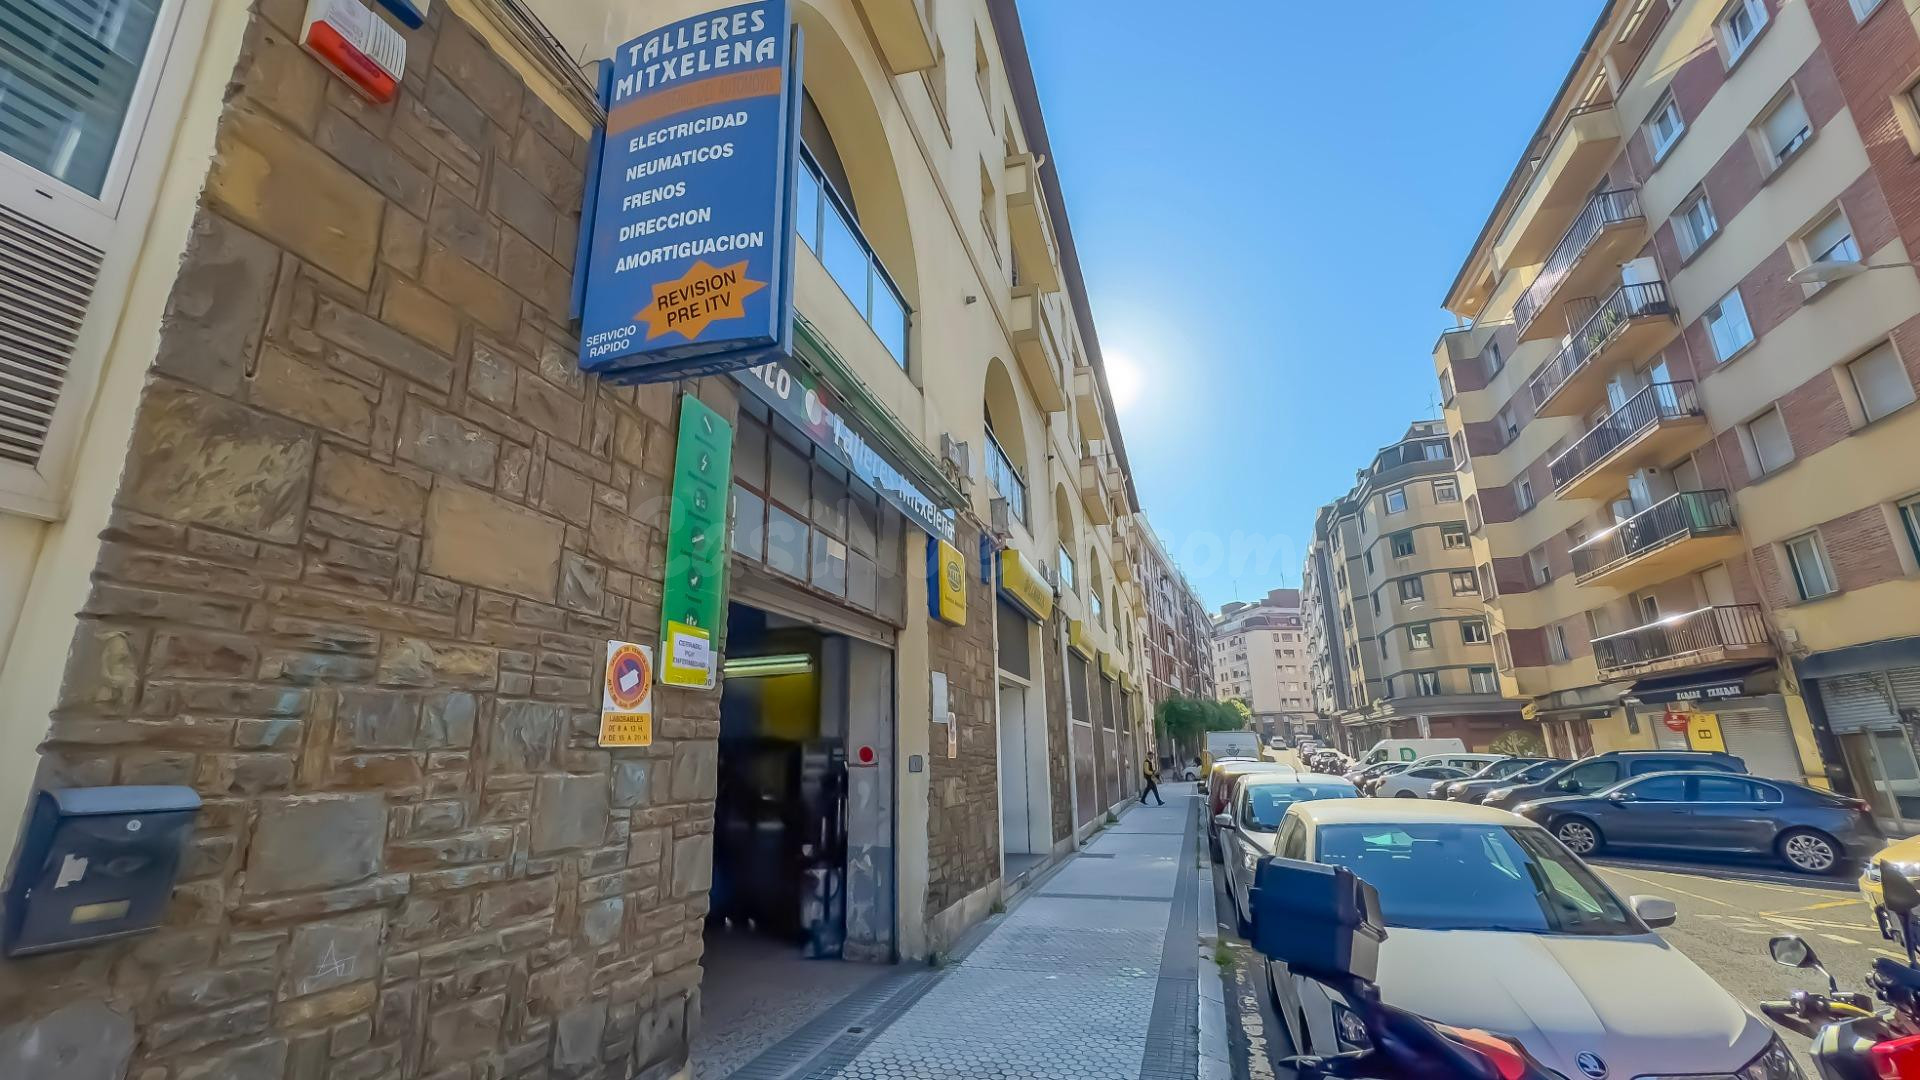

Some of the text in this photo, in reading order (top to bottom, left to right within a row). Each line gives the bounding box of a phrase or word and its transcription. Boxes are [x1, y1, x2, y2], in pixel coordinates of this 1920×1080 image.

[628, 10, 766, 68] TALLERES
[615, 36, 776, 101] MITXELENA
[629, 111, 748, 153] ELECTRICIDAD
[625, 143, 735, 182] NEUMATICOS
[622, 182, 687, 212] FRENOS
[619, 207, 712, 242] DIRECCION
[614, 232, 765, 274] AMORTIGUACION
[657, 270, 737, 311] REVISION
[667, 292, 731, 327] PRE ITV
[586, 325, 637, 347] SERVICIO
[589, 339, 630, 358] RAPIDO
